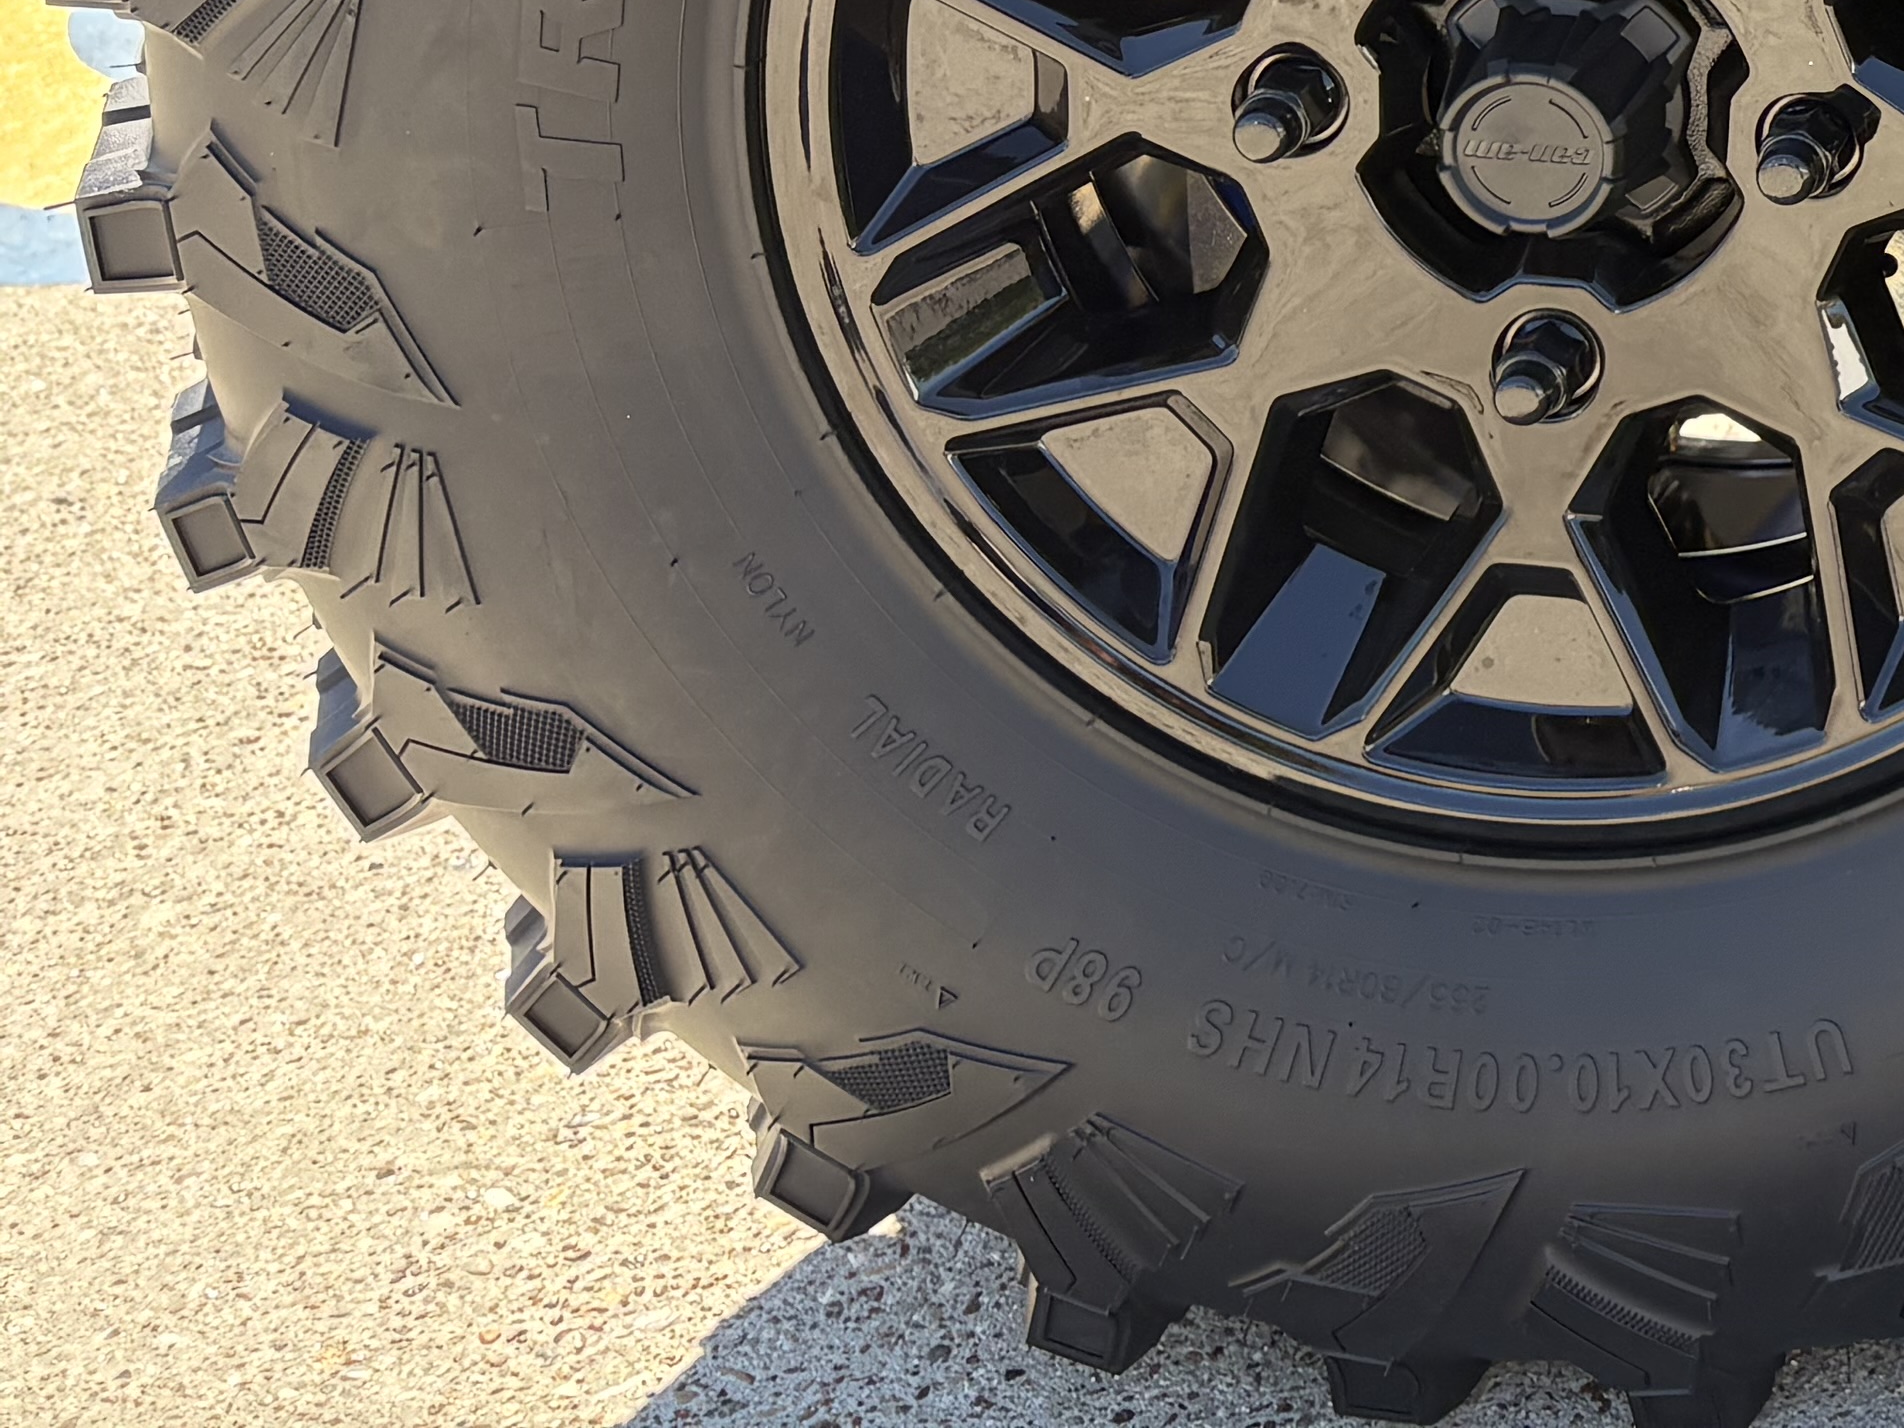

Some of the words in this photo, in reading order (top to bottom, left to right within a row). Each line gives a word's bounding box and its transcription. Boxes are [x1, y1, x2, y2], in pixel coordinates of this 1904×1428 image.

[729, 551, 817, 646] NYLON
[849, 692, 1012, 842] RADIAL
[1021, 933, 1143, 1024] 98P
[1184, 997, 1334, 1090] NHS
